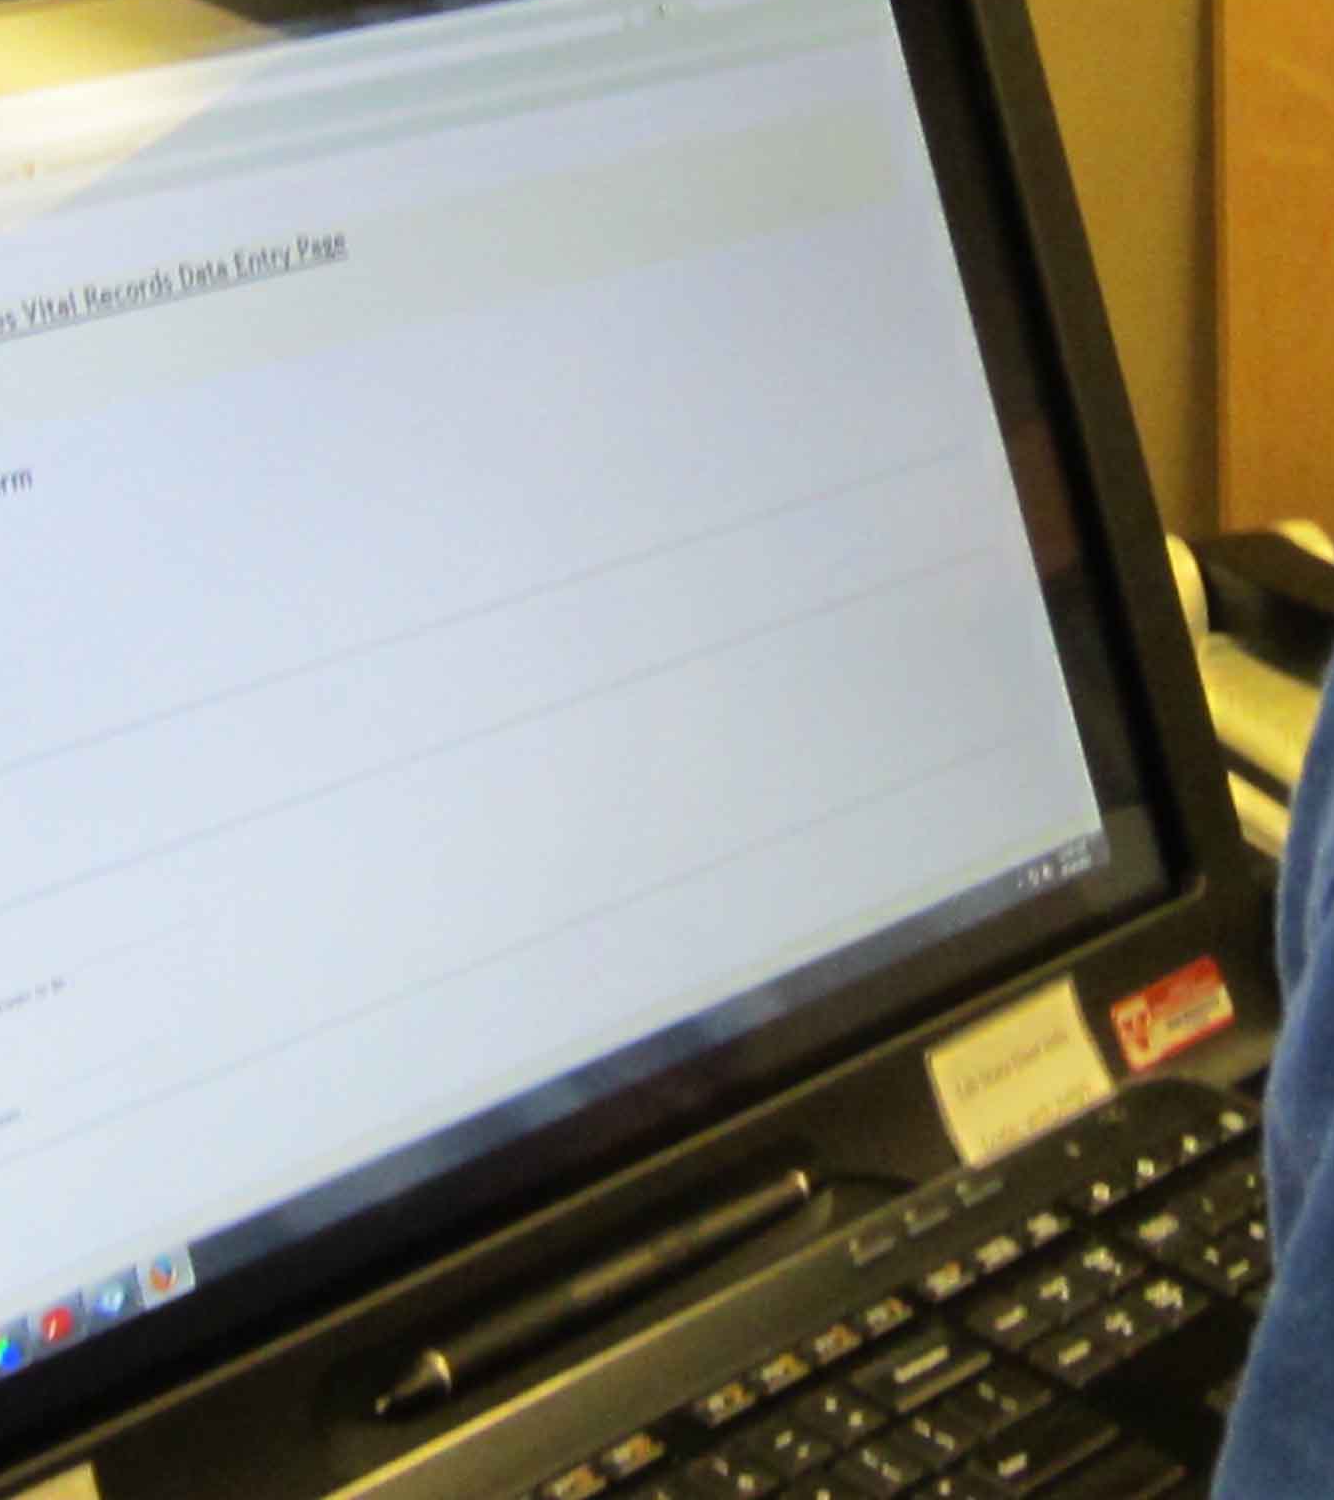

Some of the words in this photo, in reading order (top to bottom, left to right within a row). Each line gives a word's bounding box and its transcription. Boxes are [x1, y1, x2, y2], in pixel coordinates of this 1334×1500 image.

[21, 290, 77, 328] Vital
[83, 269, 172, 313] Records
[177, 261, 228, 292] Data
[232, 247, 294, 283] Entry
[295, 233, 347, 268] Page
